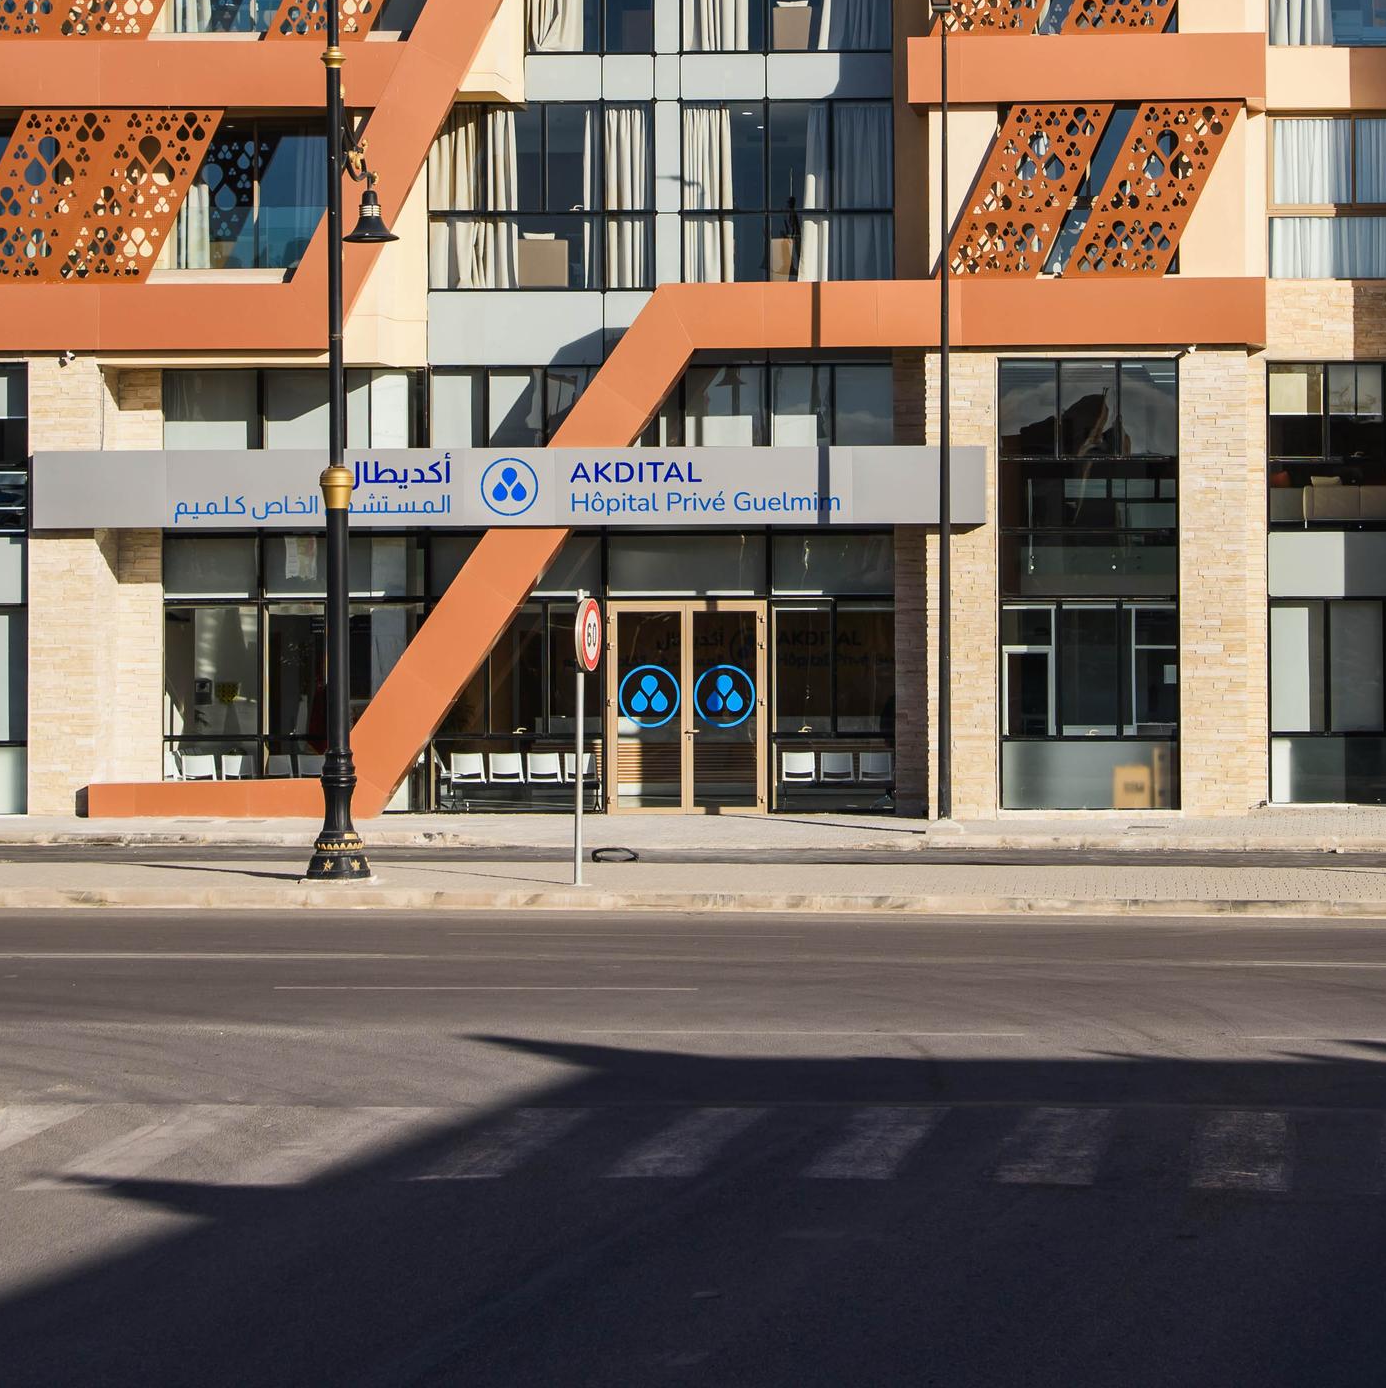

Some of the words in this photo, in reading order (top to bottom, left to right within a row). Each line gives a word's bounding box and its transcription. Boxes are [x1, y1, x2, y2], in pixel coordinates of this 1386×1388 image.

[570, 461, 703, 484] AKDITAL
[174, 495, 247, 524] كلميم
[251, 494, 318, 520] الخاص
[325, 493, 451, 516] المستش
[571, 491, 659, 516] Hôpital
[666, 490, 726, 512] Privé
[733, 490, 841, 512] Guelmim
[587, 622, 597, 647] 60
